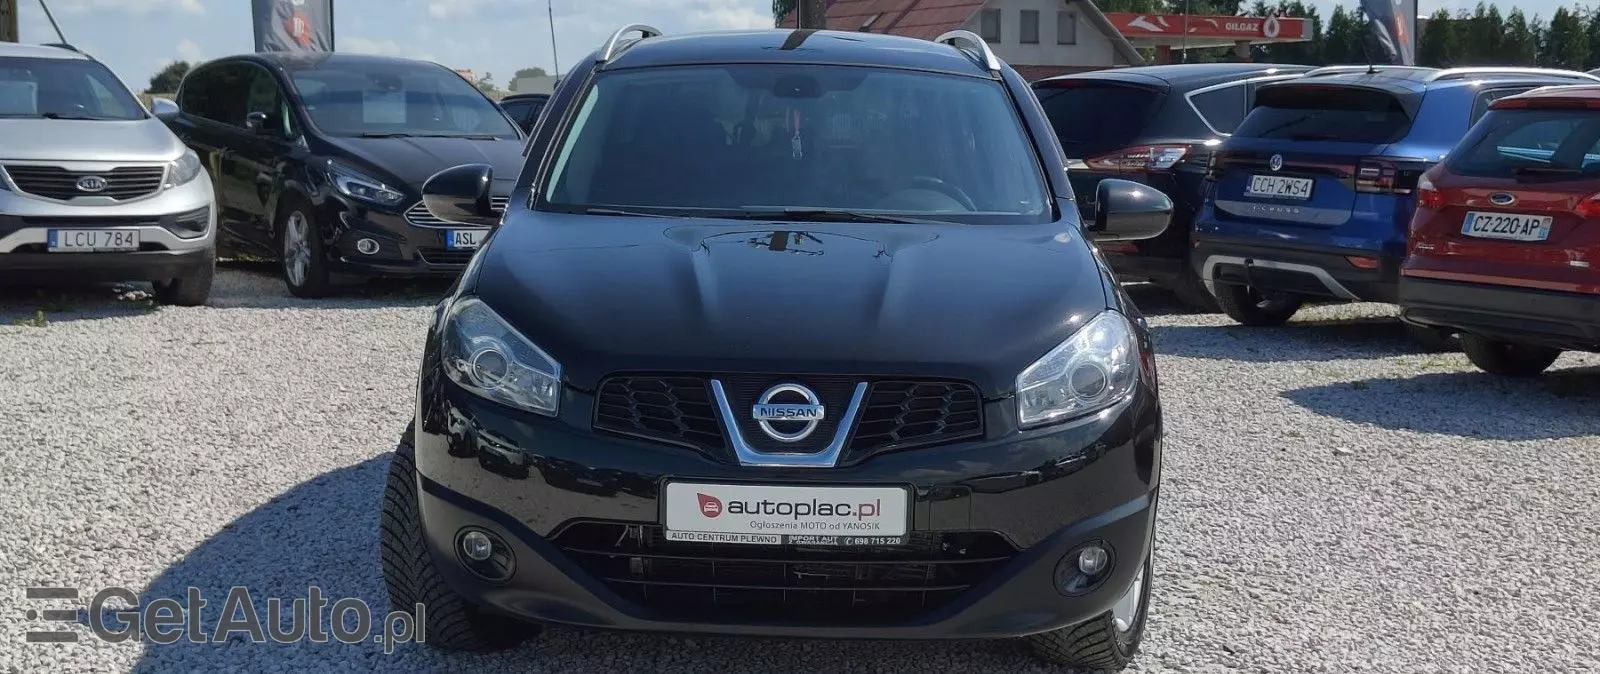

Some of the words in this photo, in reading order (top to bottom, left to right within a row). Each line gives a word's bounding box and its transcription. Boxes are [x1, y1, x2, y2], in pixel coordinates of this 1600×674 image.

[81, 180, 103, 189] KIA
[1253, 177, 1276, 192] CCH
[1277, 179, 1309, 196] 2WS4
[64, 231, 97, 247] LCU
[104, 231, 134, 247] 784
[455, 232, 477, 245] ASL
[760, 407, 817, 417] NISSAN
[727, 498, 881, 521] autoplac.pl
[749, 520, 798, 530] Ogłoszenia
[800, 521, 827, 530] MOTO
[829, 521, 841, 530] od
[842, 521, 880, 530] YANOSIK
[671, 532, 695, 540] AUTO
[697, 533, 739, 542] CENTRUM
[740, 534, 777, 543] PLEWNO
